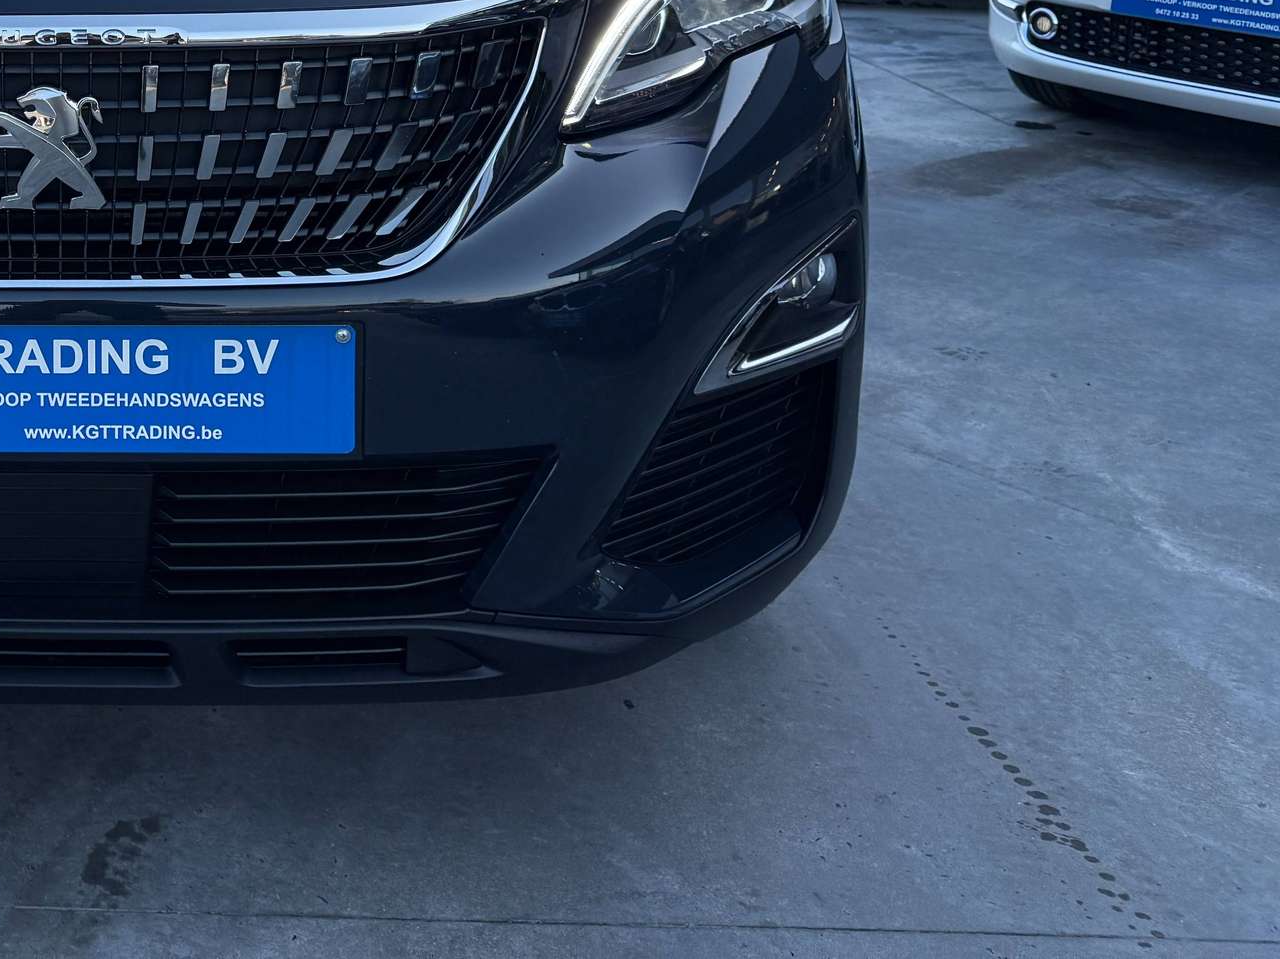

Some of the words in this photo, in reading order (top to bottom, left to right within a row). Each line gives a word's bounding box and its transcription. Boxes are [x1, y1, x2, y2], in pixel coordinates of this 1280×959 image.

[1182, 0, 1218, 10] VERKOOP
[214, 339, 279, 375] BV
[37, 392, 265, 408] TWEEDEHANDSWAGENS
[23, 424, 223, 440] www.KGTTRADING.be
